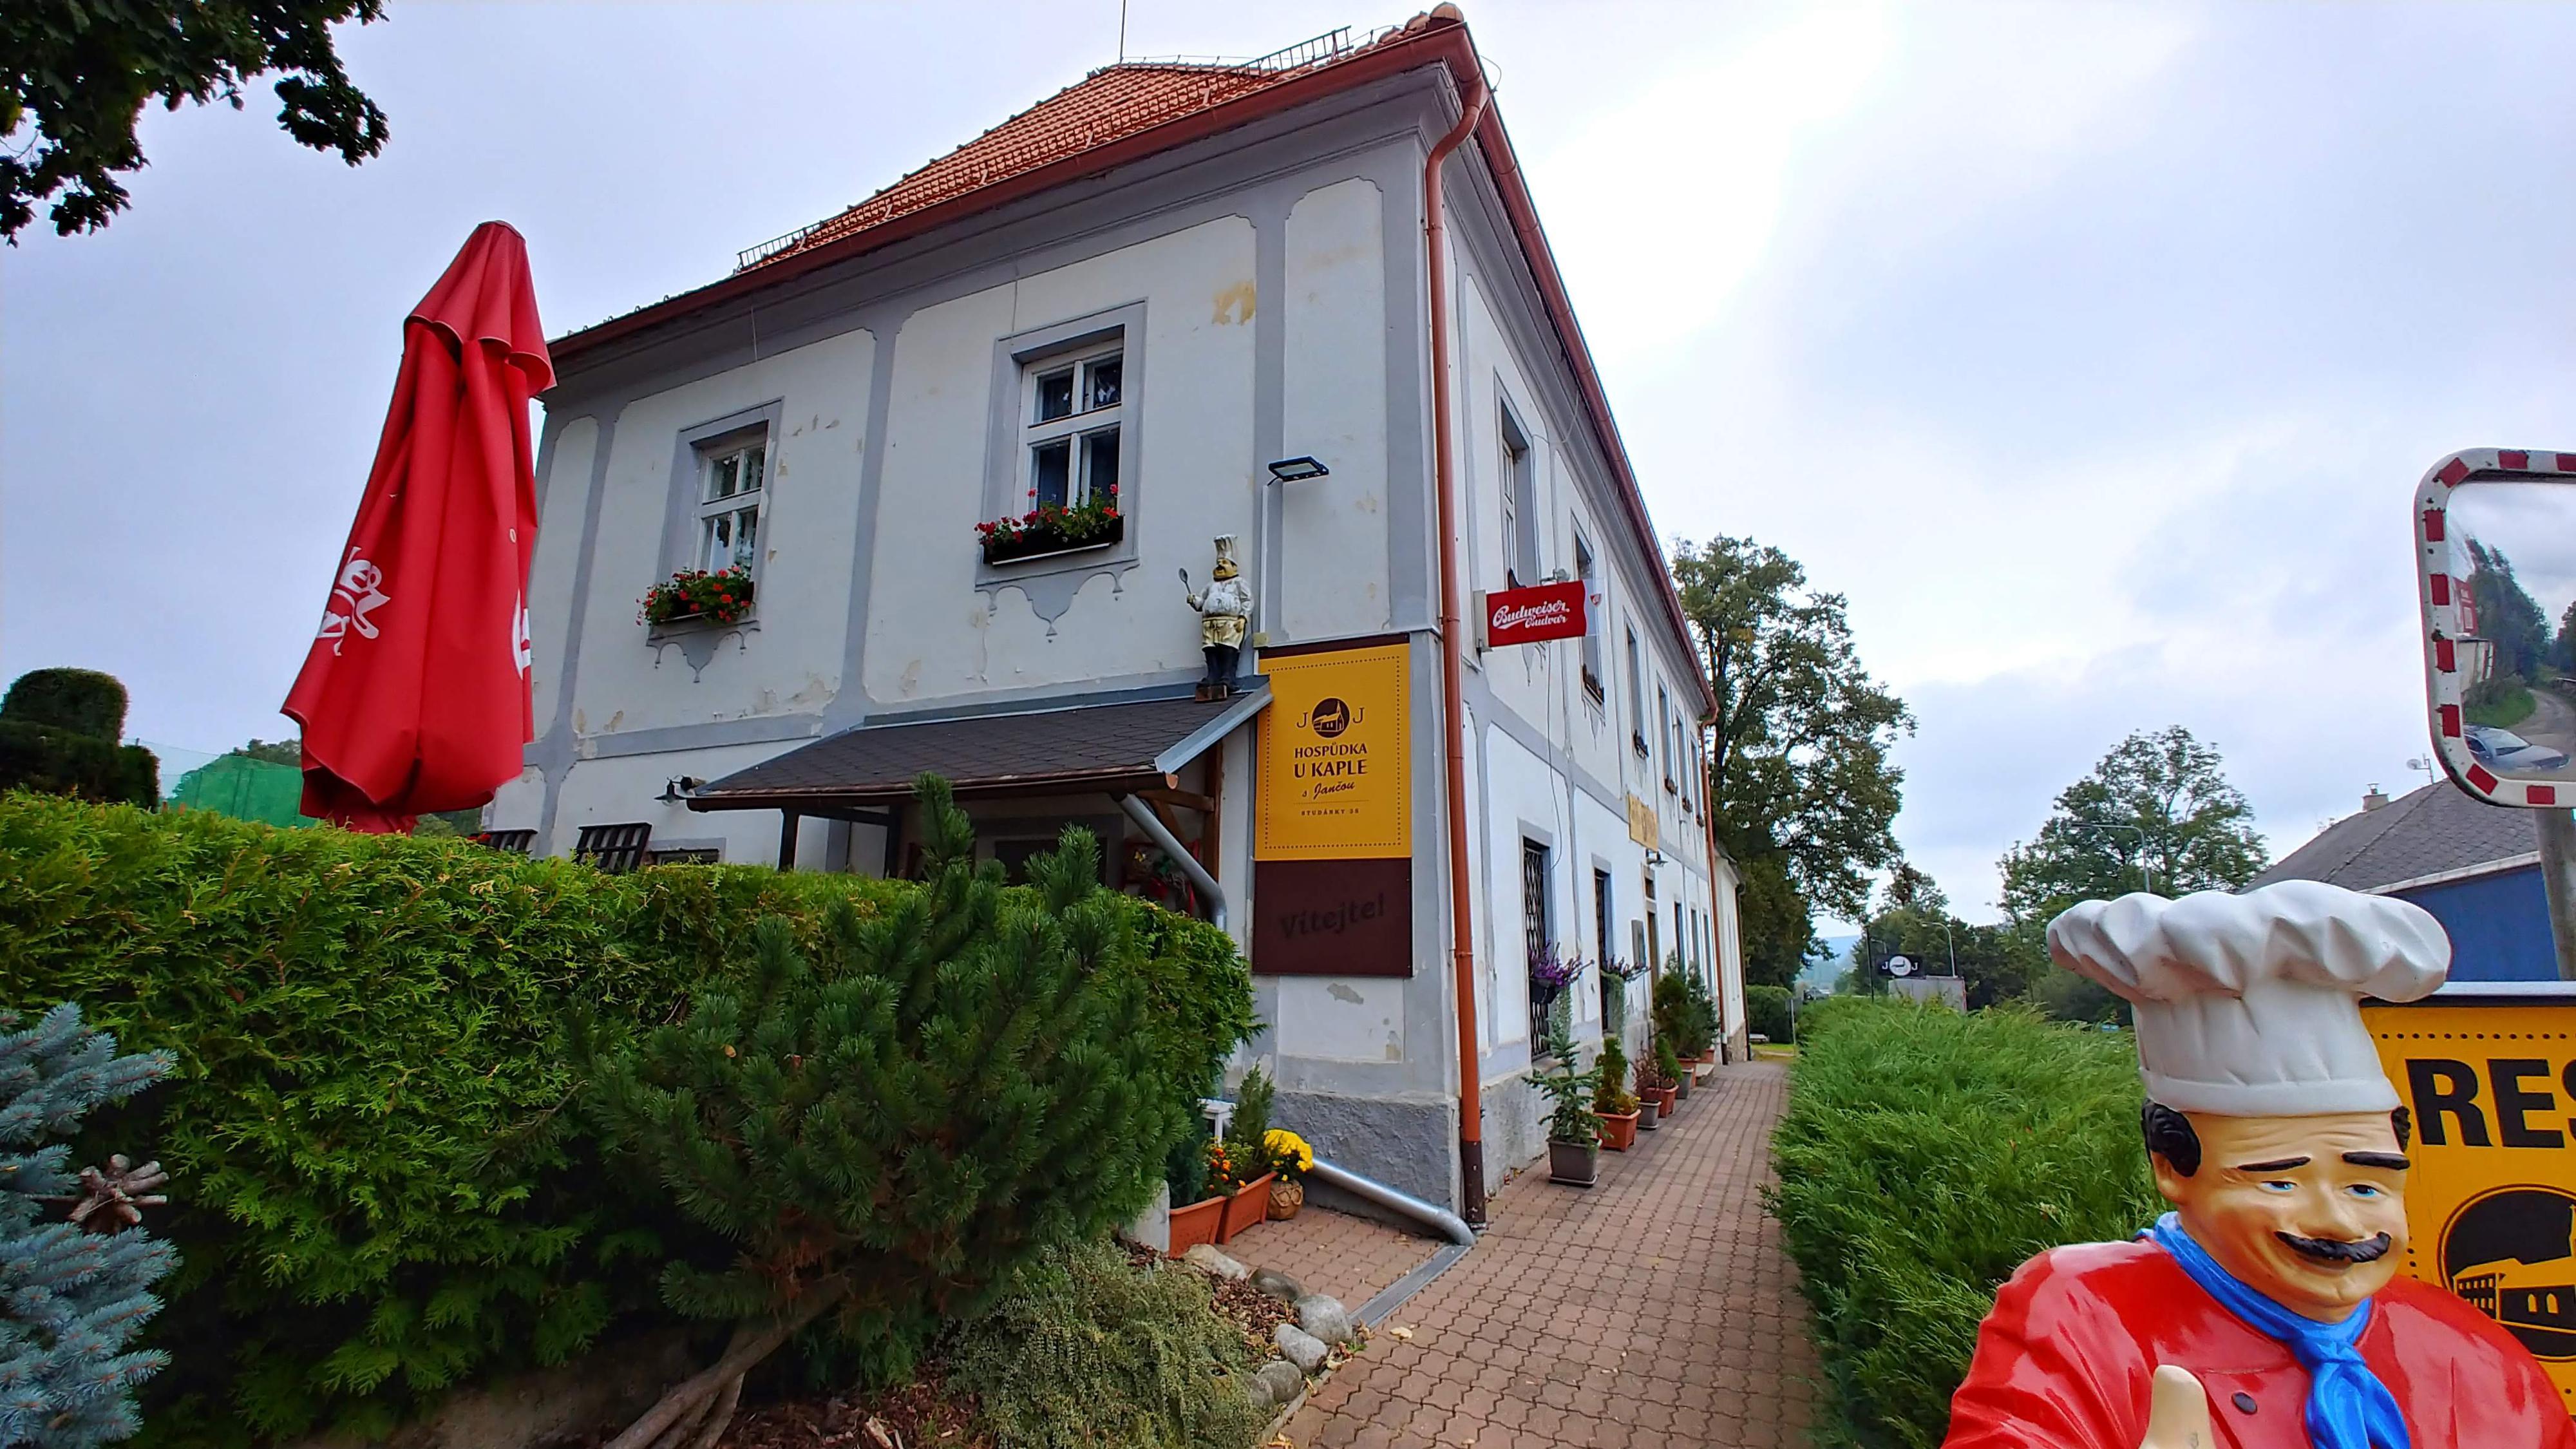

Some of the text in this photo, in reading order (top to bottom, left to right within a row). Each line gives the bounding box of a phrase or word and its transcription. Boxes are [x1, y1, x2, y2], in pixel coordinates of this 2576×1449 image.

[1492, 600, 1570, 629] Budweiser
[1524, 614, 1568, 629] Budvar
[1296, 707, 1365, 728] J J
[1294, 741, 1368, 759] HOSPŮDKA
[1294, 759, 1368, 778] U KAPLE
[1313, 781, 1356, 800] Jančou
[2405, 1057, 2576, 1149] RE
